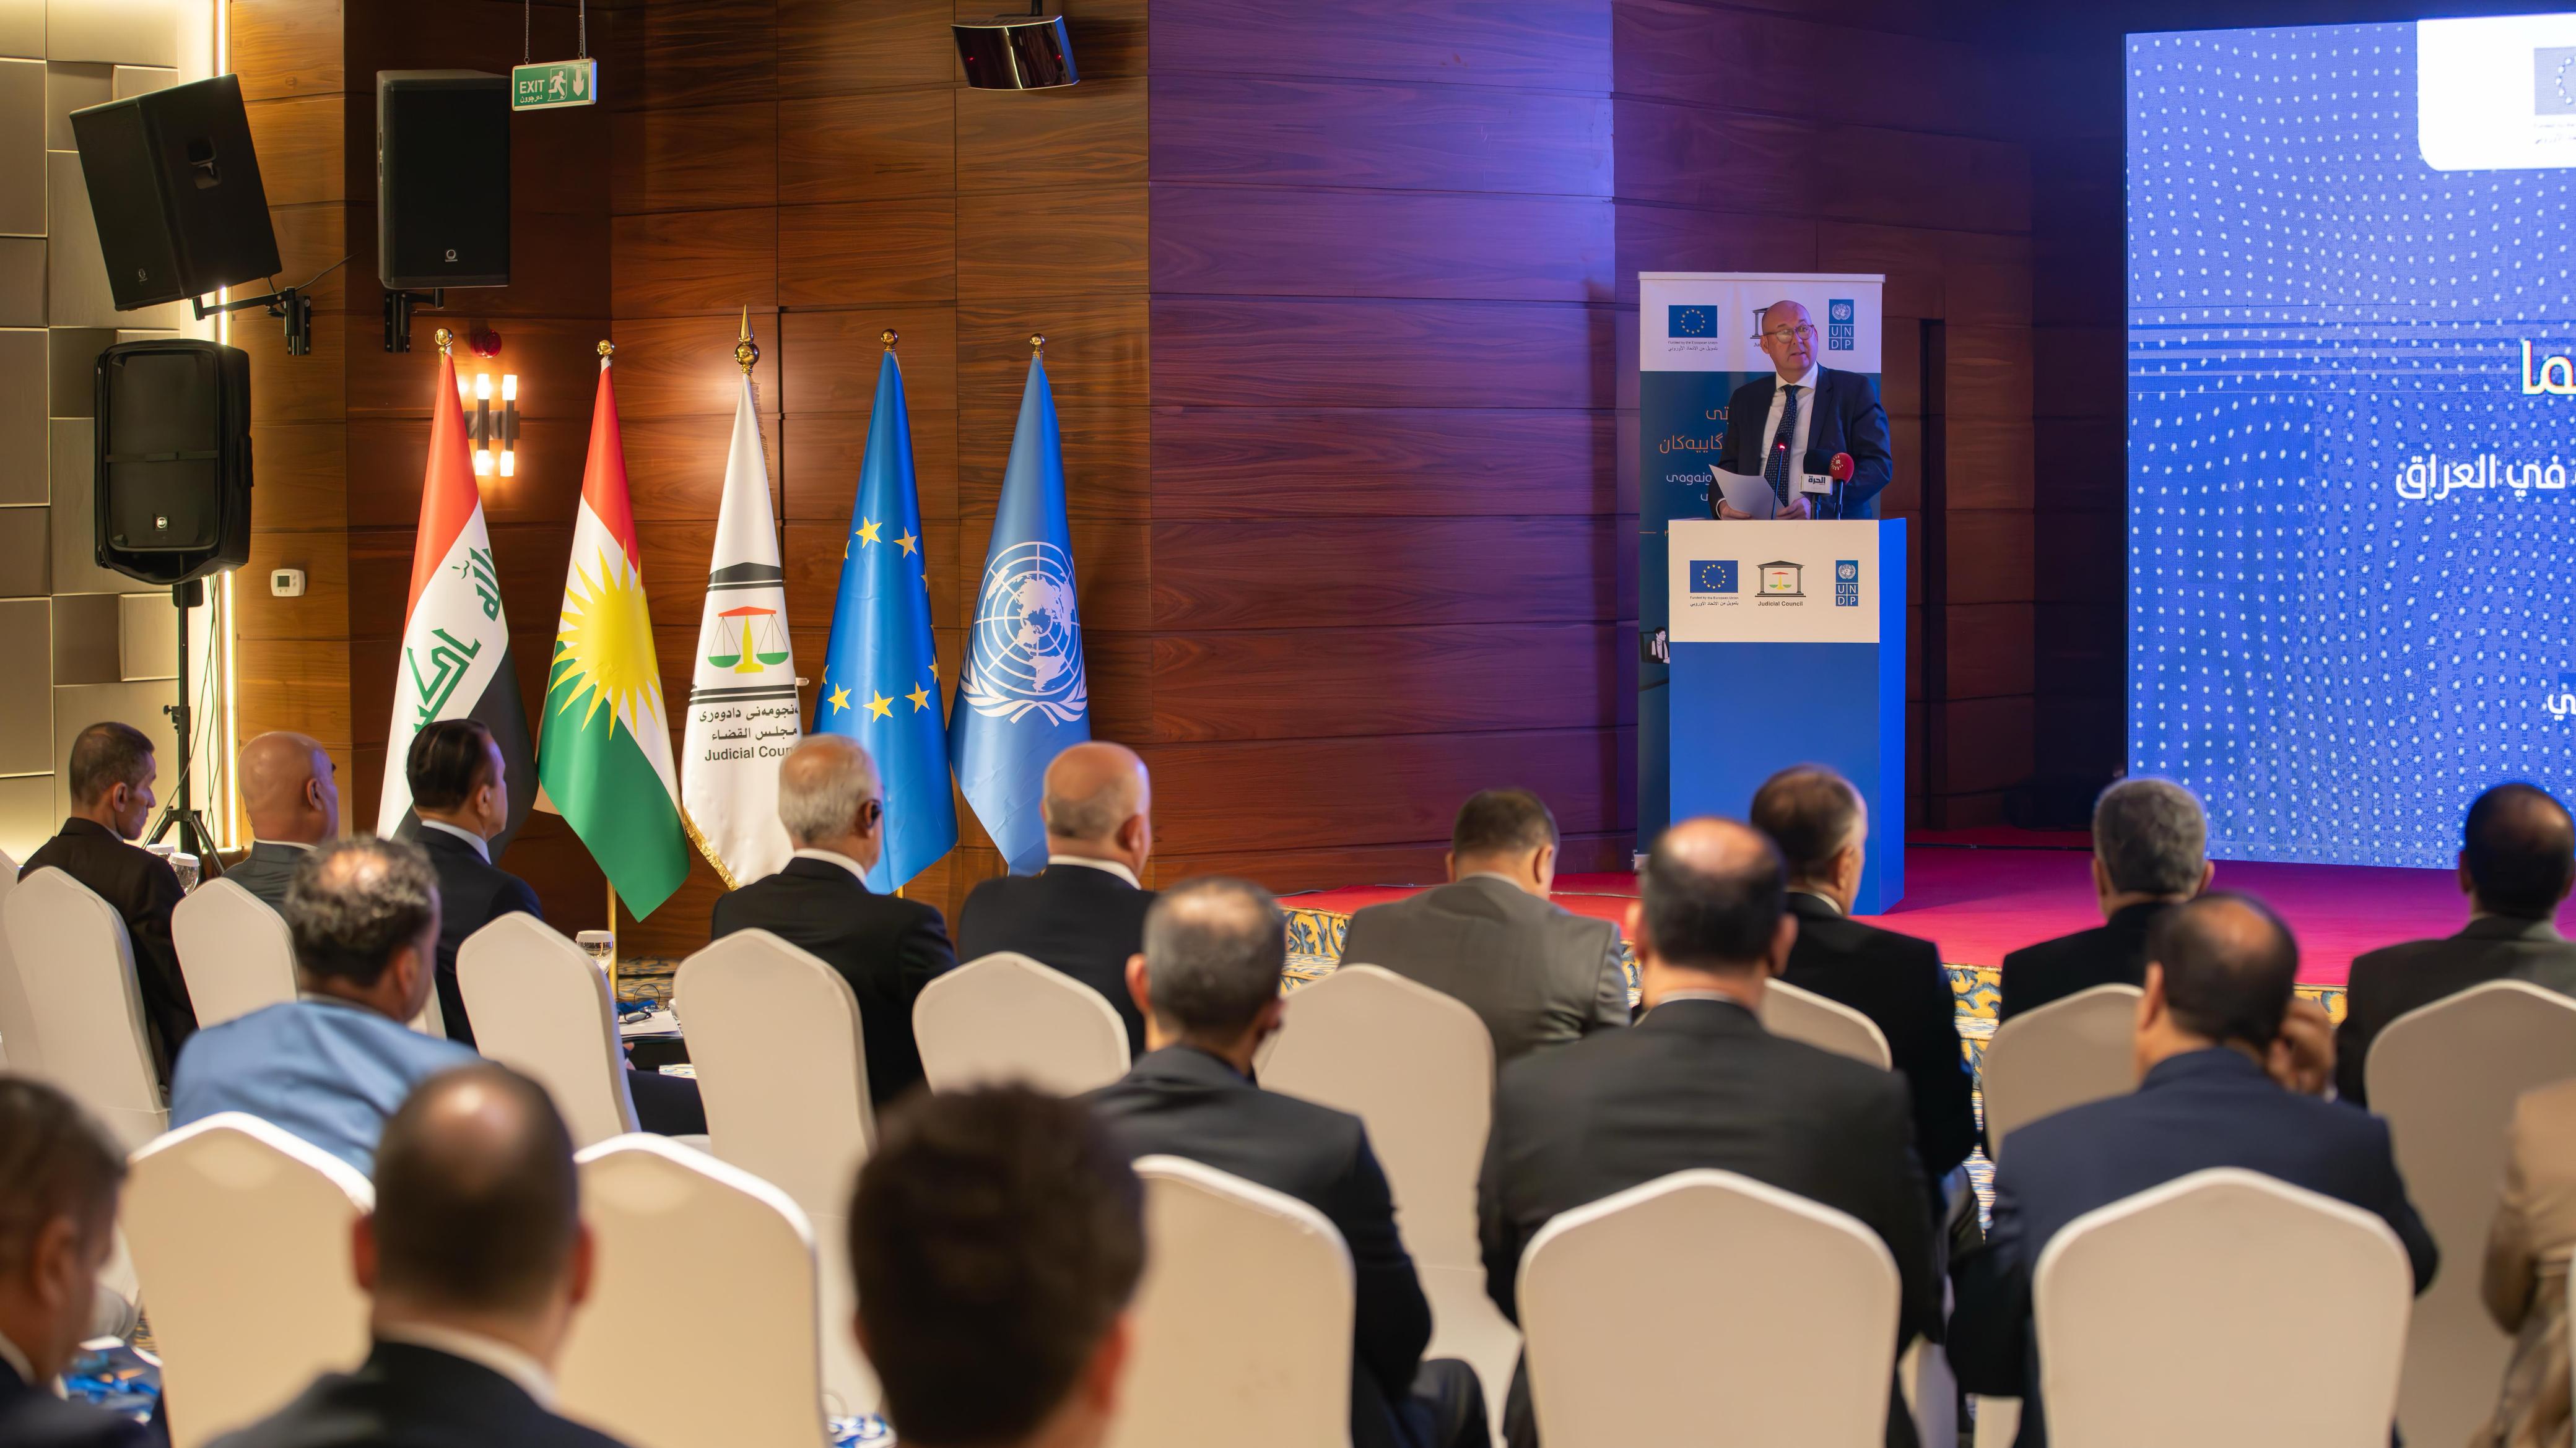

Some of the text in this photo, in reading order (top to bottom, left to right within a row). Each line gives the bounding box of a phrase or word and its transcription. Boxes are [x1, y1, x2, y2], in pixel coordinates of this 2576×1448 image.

[520, 79, 545, 93] EXIT
[1808, 475, 1825, 485] الحرة
[2396, 454, 2565, 500] في العراق
[712, 726, 798, 741] مجلس القضاء
[705, 745, 793, 761] Judicial Coun
